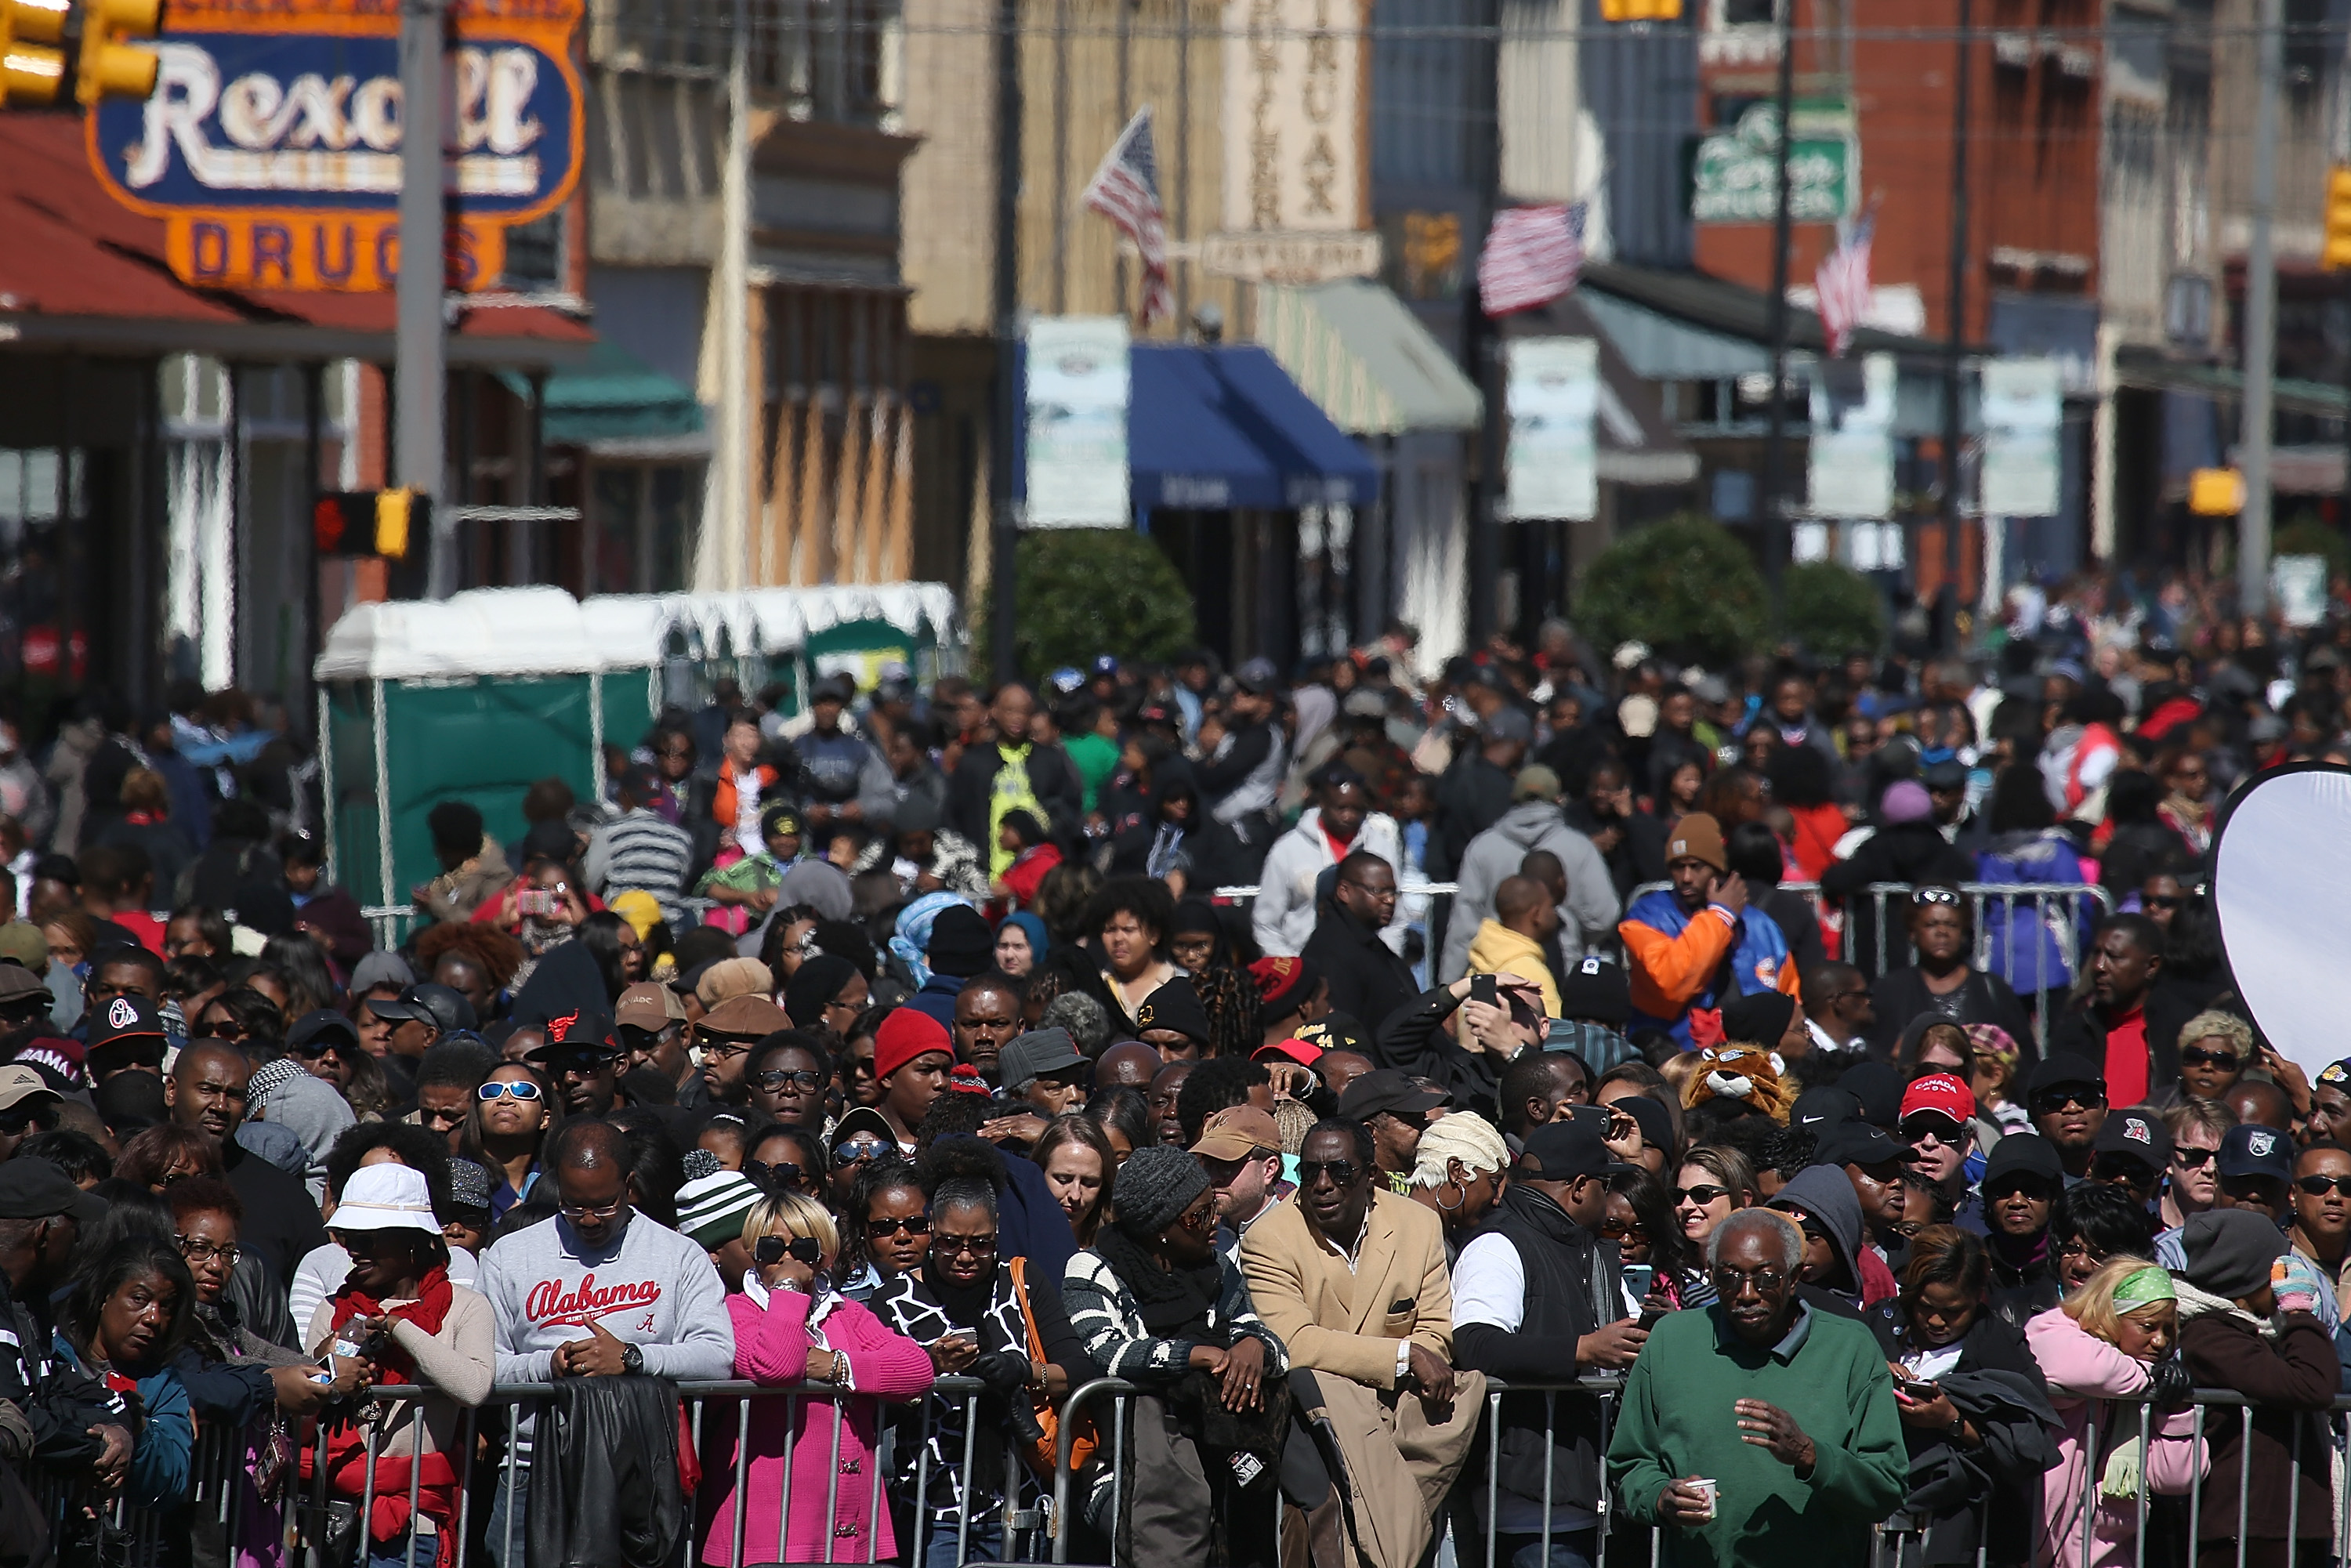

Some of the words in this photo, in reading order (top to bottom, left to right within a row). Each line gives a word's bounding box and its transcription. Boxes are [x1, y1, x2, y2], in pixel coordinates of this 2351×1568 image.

[124, 42, 546, 191] Rexall
[1316, 1034, 1333, 1048] 44
[14, 1048, 67, 1077] BAMA
[1914, 1080, 1957, 1094] CANADA
[525, 1273, 661, 1323] Alabama
[565, 1313, 589, 1324] CRIMS
[636, 1313, 654, 1333] A
